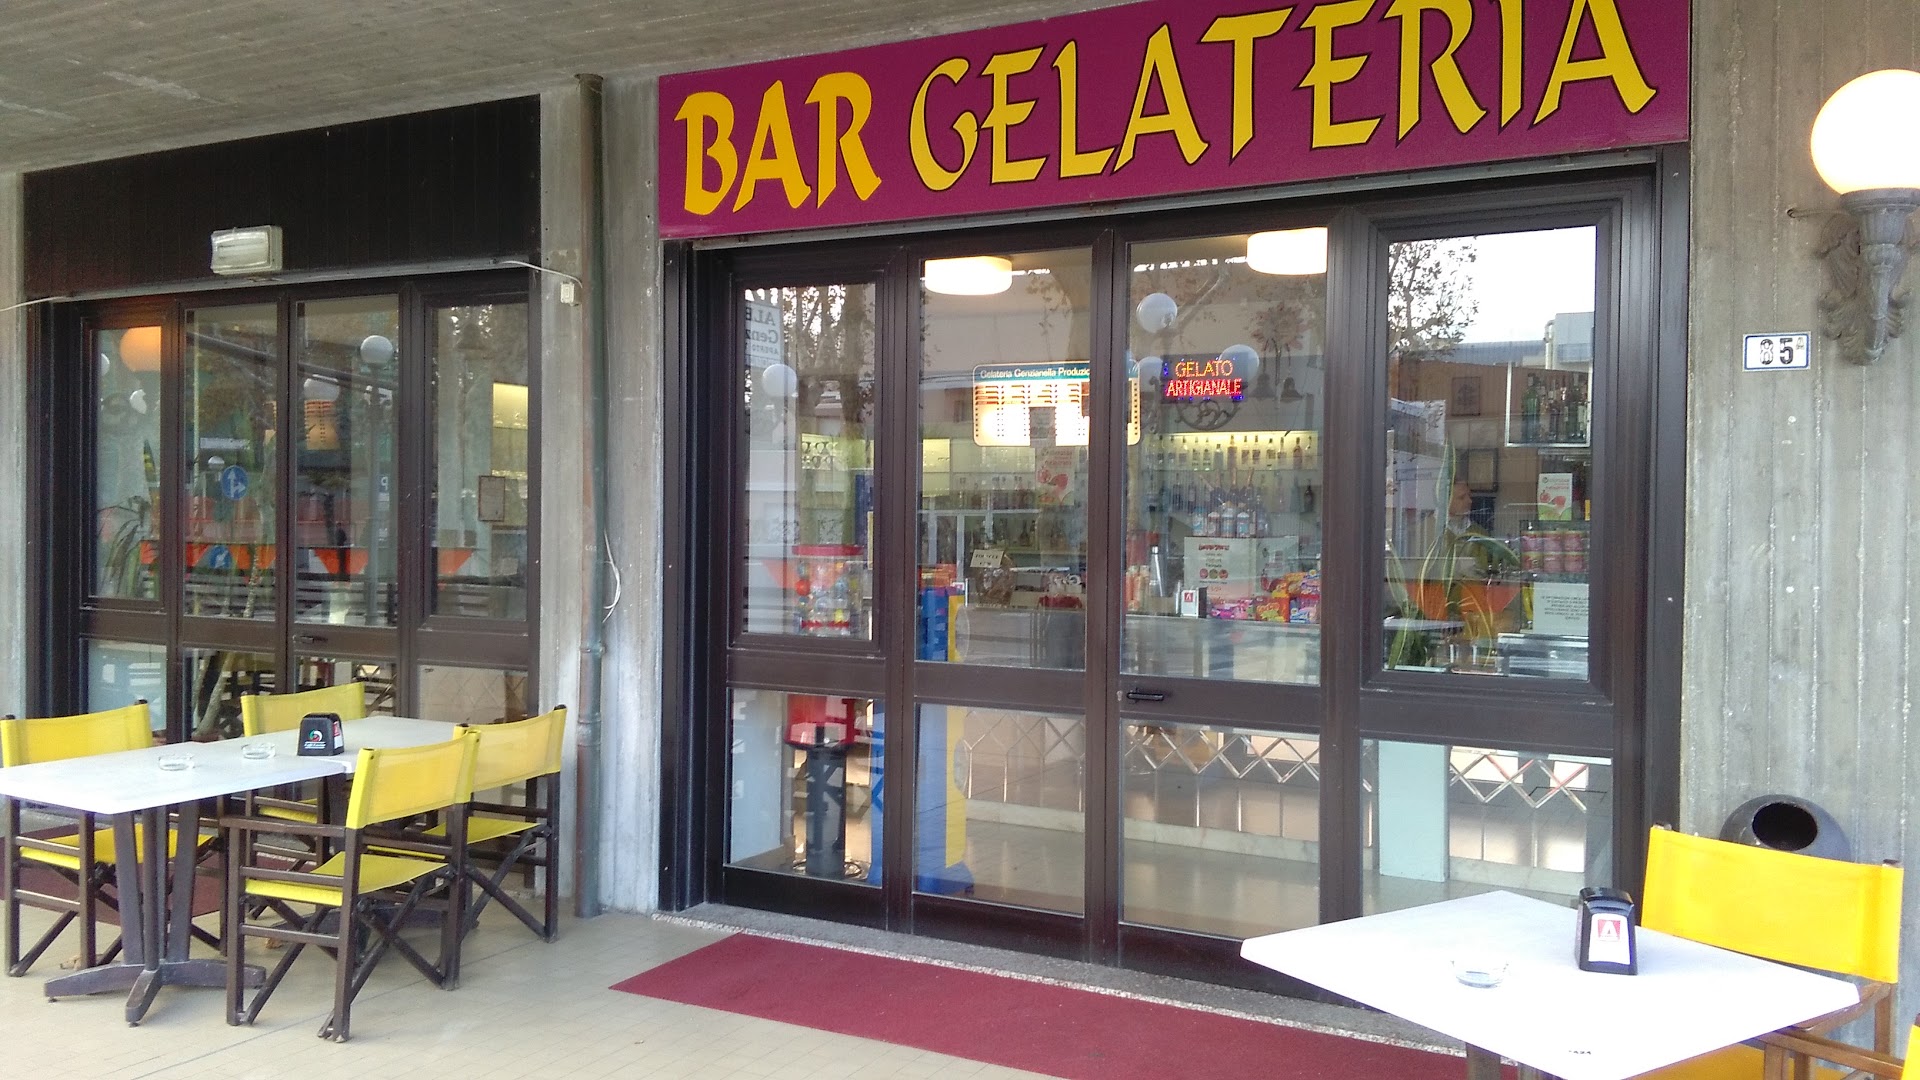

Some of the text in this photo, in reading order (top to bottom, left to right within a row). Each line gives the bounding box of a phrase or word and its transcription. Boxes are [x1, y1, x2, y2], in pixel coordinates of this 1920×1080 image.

[675, 0, 1657, 216] BAR GELATERIA
[1759, 337, 1794, 365] 85
[980, 369, 1013, 379] Gelateria
[1013, 367, 1057, 378] Genzianella
[1175, 360, 1233, 377] GELATO
[1165, 377, 1243, 397] ARTIGIANALE
